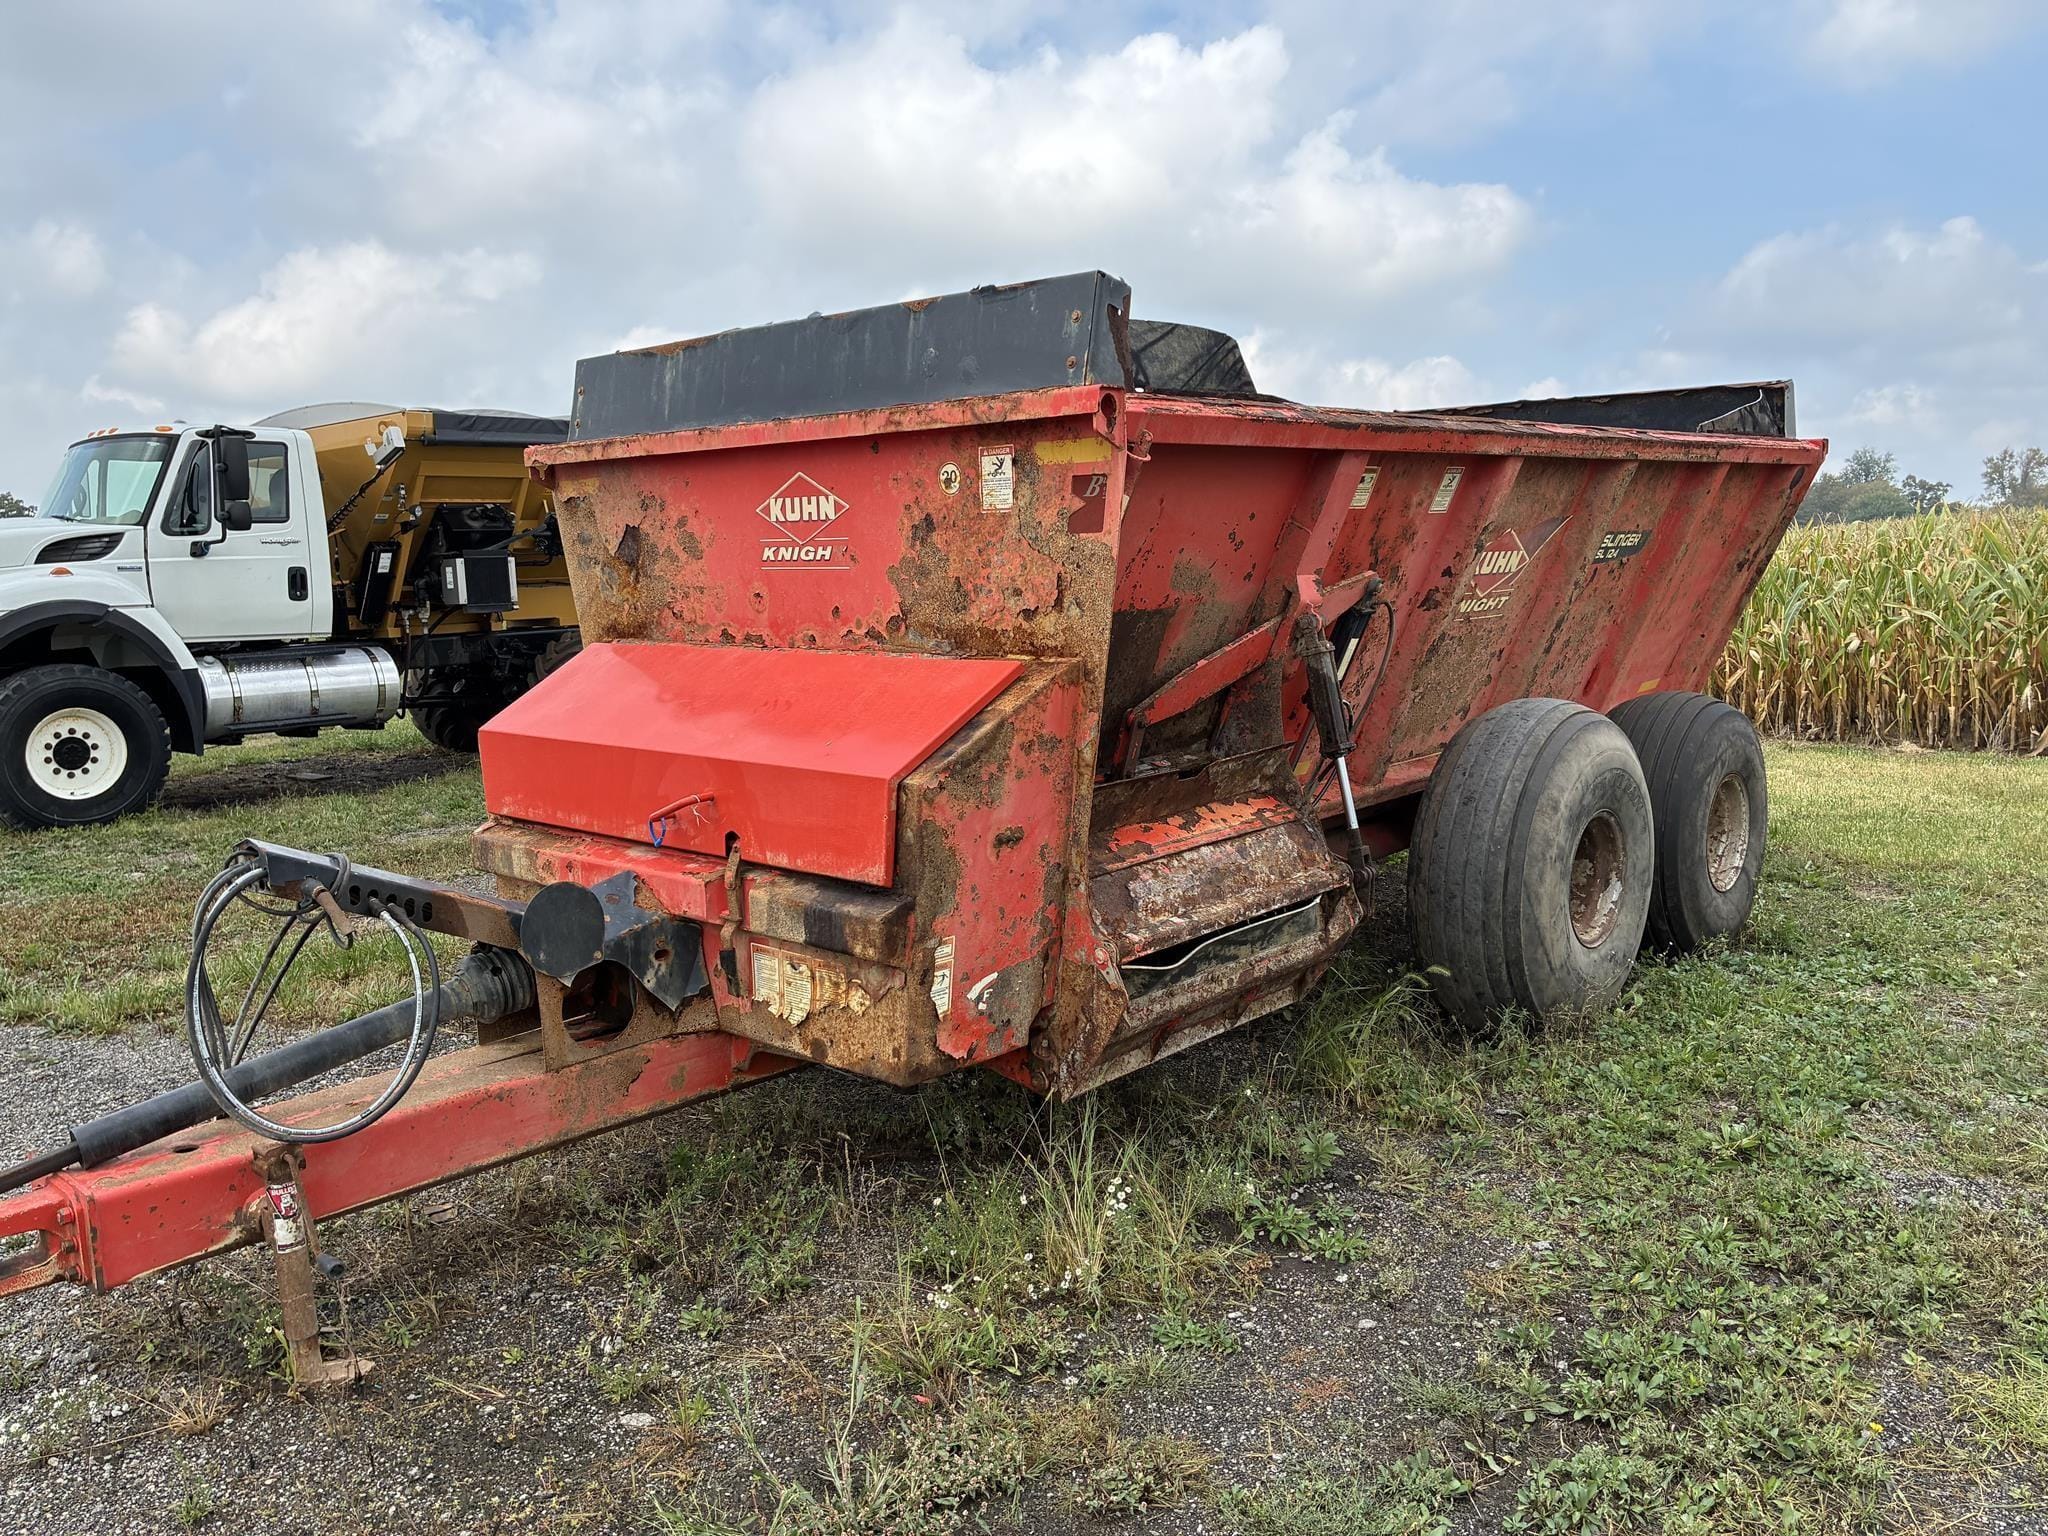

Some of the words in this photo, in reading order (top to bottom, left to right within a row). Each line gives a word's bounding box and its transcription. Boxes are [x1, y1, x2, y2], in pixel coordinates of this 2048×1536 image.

[988, 447, 1010, 455] DANGER
[769, 495, 836, 522] KUHN
[1600, 533, 1642, 548] SLINGER
[762, 545, 836, 562] KNIGH
[1459, 595, 1509, 613] NIGHT
